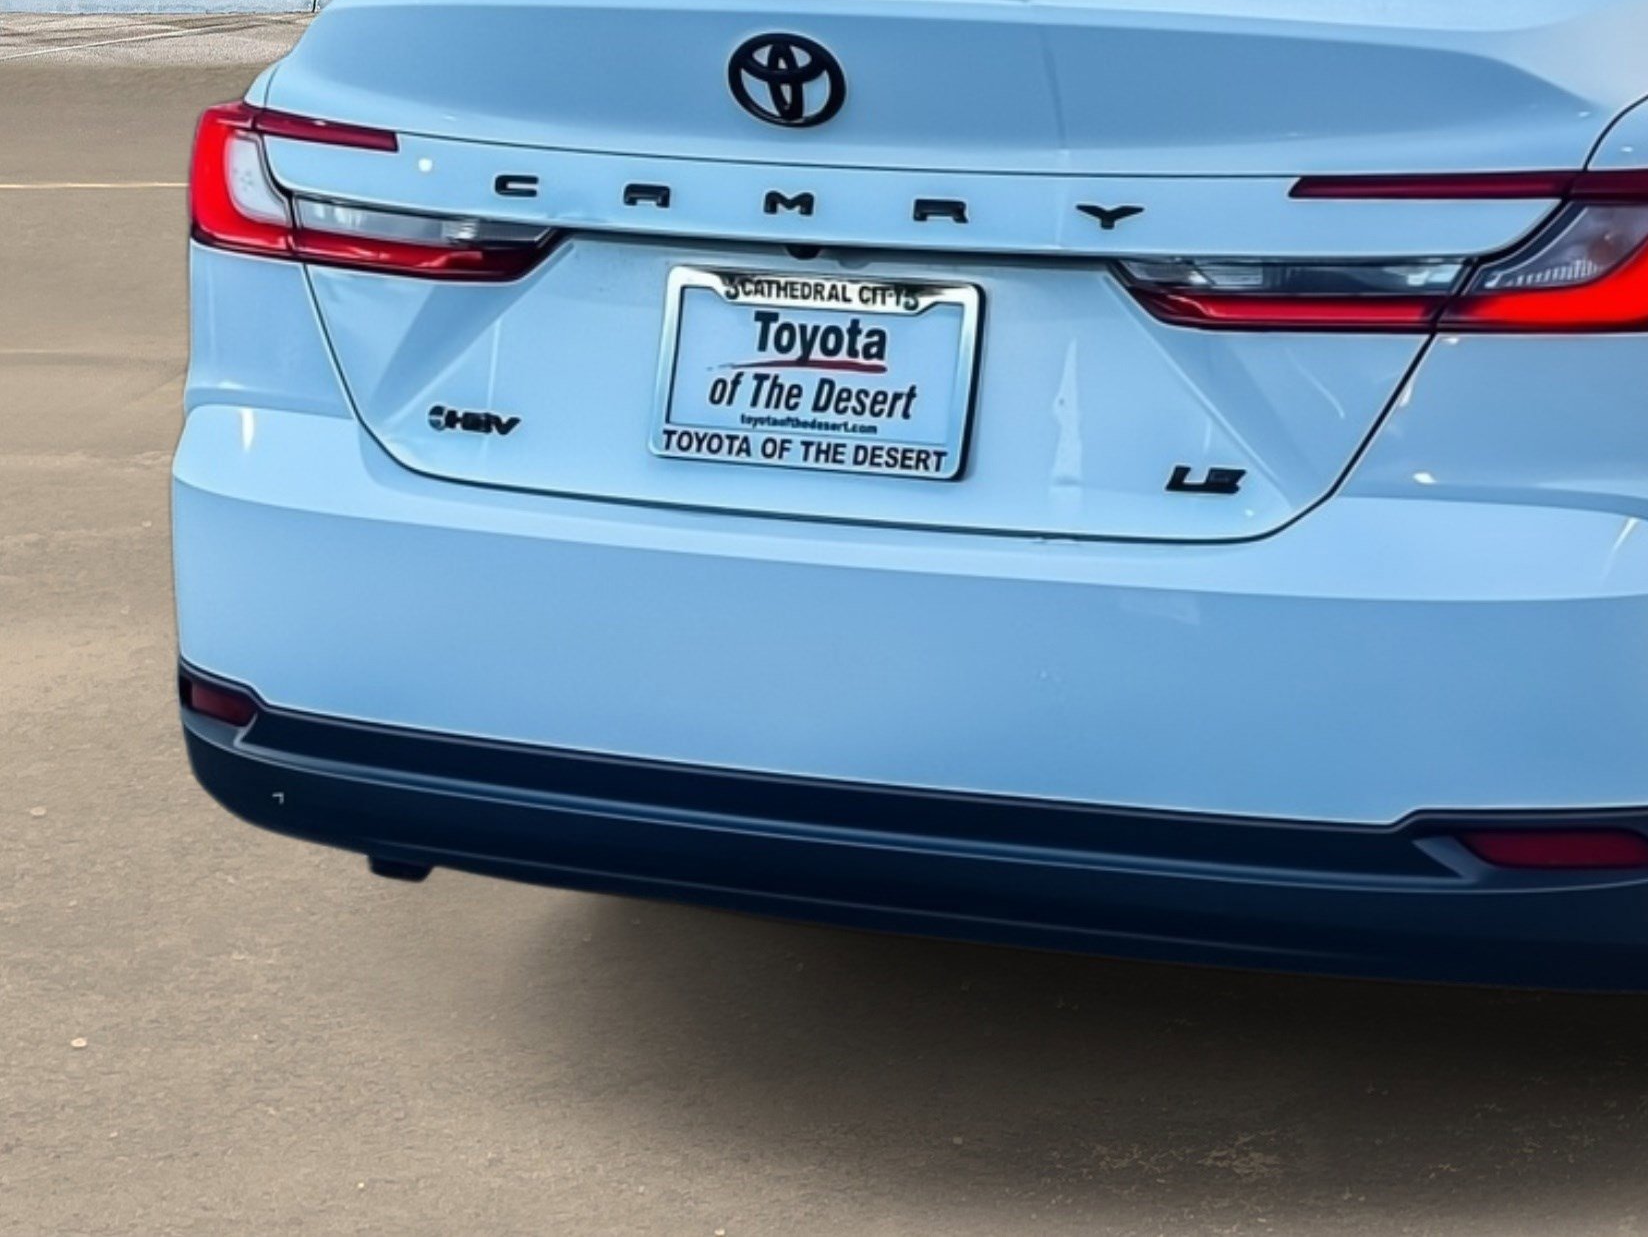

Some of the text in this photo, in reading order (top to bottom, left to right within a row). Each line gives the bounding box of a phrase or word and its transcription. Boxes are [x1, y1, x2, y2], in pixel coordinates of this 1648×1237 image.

[495, 174, 1145, 229] CAMRY
[742, 278, 852, 303] CATHEDRAL
[754, 311, 887, 362] Toyota
[709, 371, 917, 420] of The Desert
[741, 413, 877, 434] toyotaofthedesert.com
[663, 429, 948, 473] TOYOTA OF THE DESERT
[1164, 465, 1247, 494] LE
